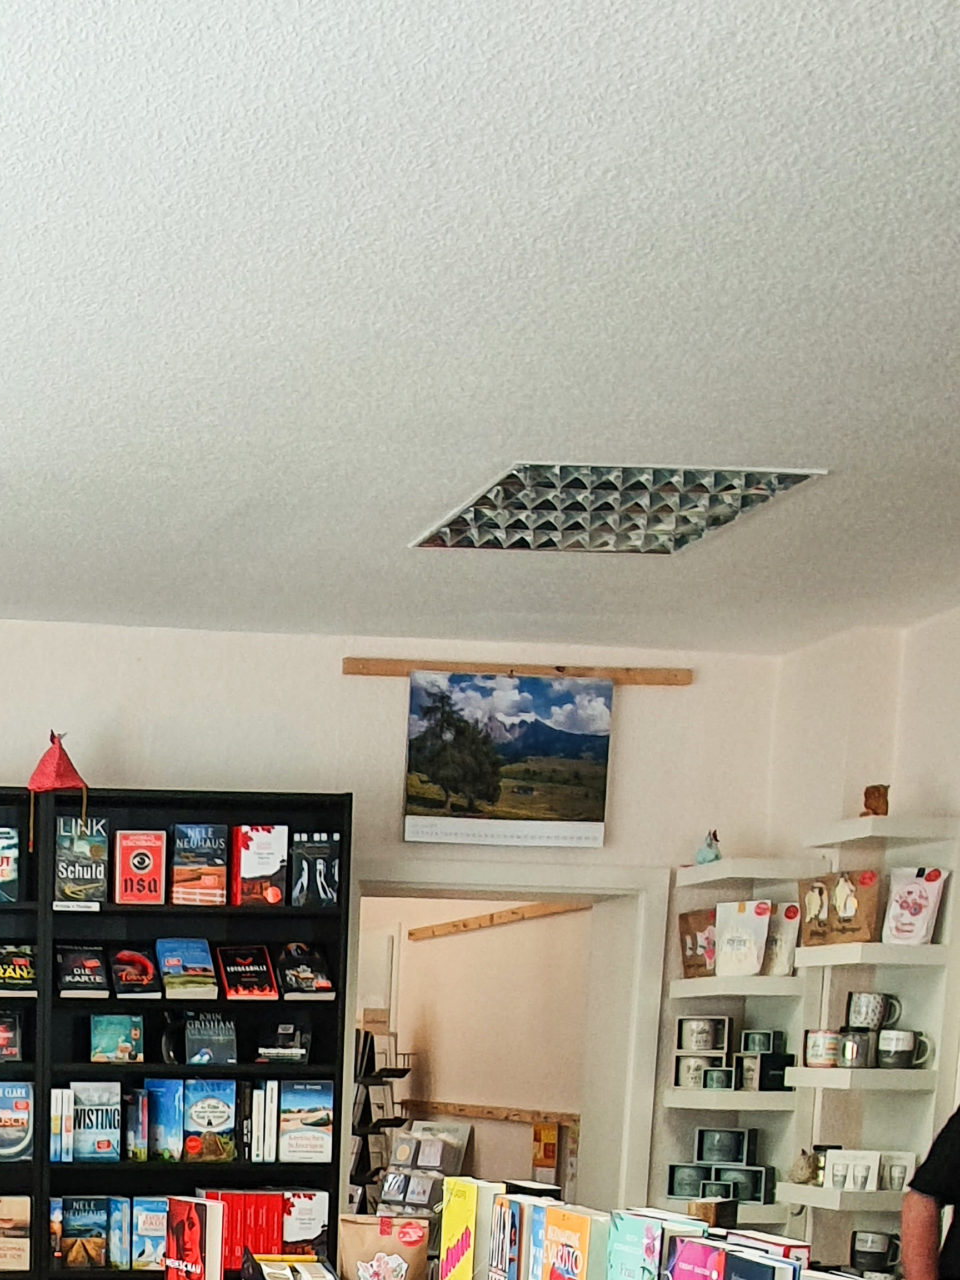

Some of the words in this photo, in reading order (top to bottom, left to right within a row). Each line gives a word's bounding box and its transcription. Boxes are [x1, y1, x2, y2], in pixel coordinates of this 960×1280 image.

[60, 818, 106, 836] LINK
[187, 827, 214, 838] NELE
[176, 838, 226, 849] NEUHAUS
[58, 862, 105, 879] Schuld
[64, 974, 103, 983] KARTE
[186, 1020, 235, 1031] GRISHAM
[6, 1088, 26, 1097] CLARK
[72, 1108, 120, 1131] WISTING
[72, 1200, 96, 1210] NELE
